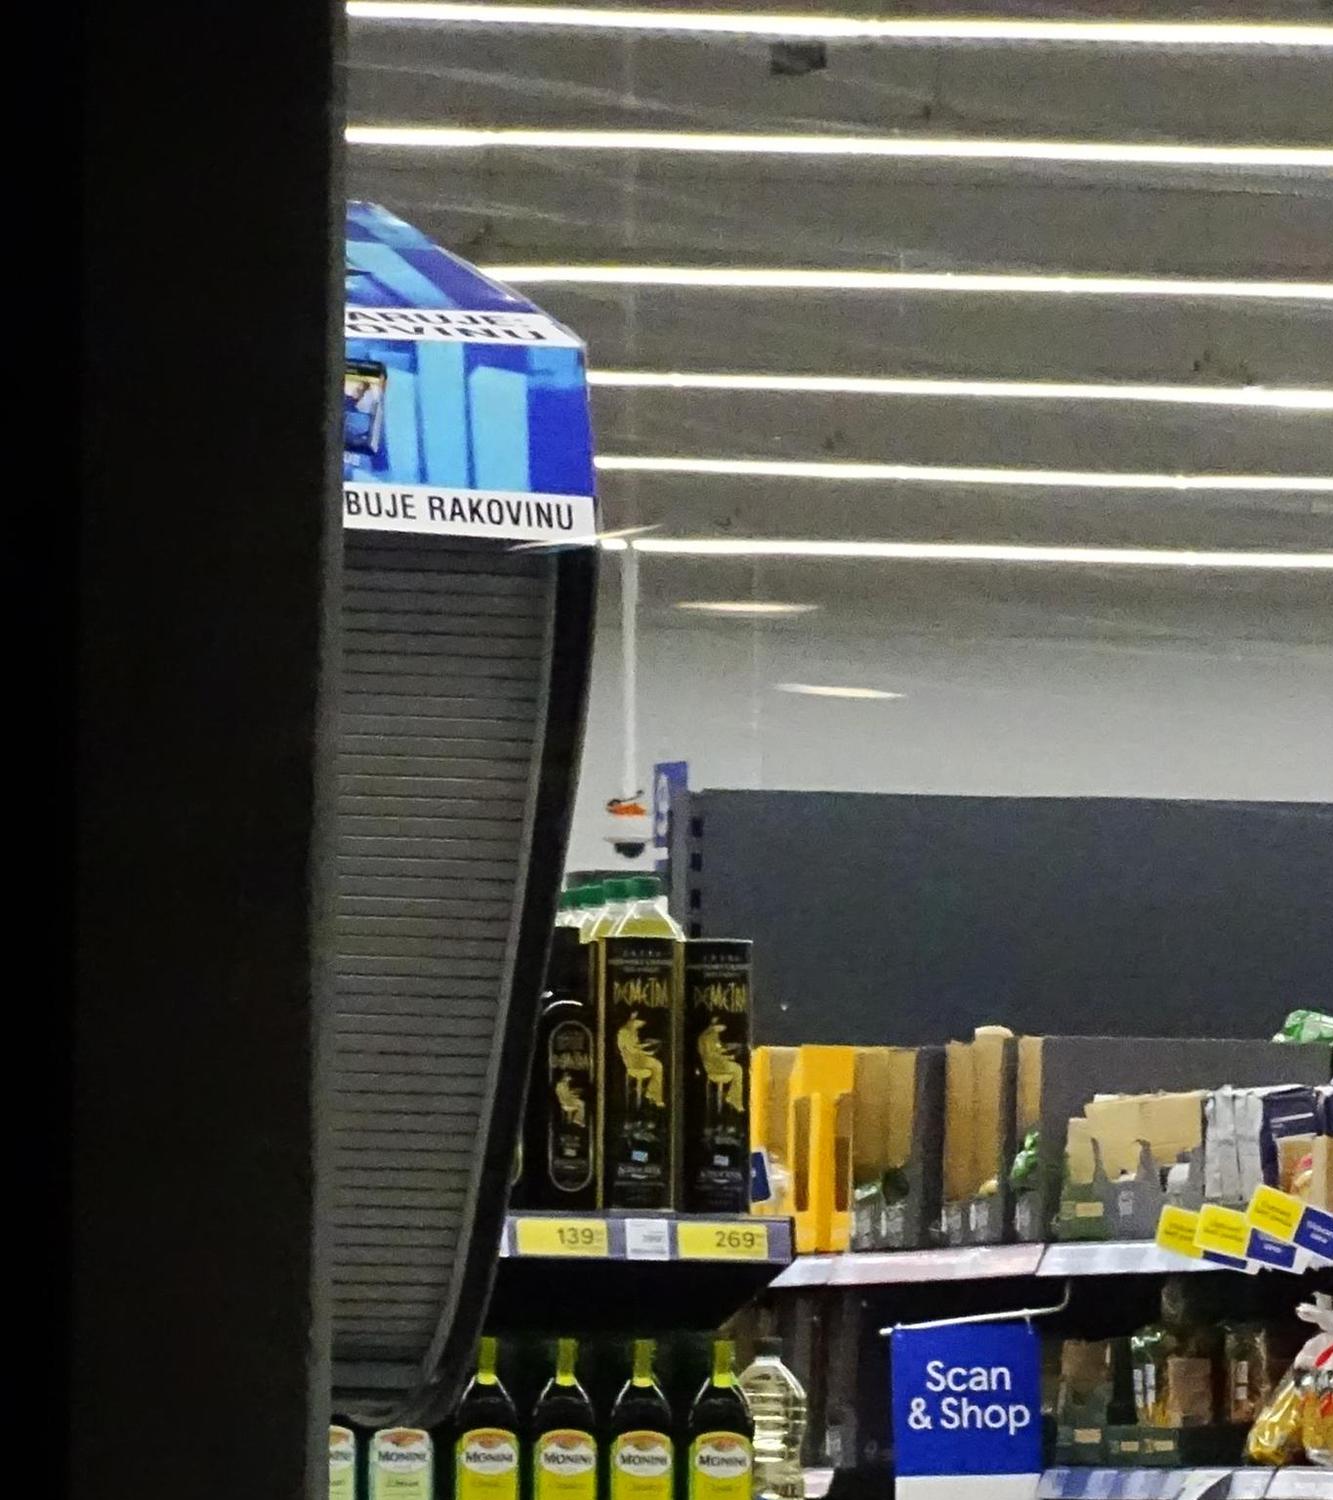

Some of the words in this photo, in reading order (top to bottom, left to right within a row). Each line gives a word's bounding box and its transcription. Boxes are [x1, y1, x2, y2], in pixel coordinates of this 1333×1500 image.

[345, 491, 417, 520] BUJE
[428, 495, 573, 531] RAKOVINU
[557, 1227, 594, 1246] 139
[715, 1231, 755, 1249] 269
[926, 1360, 1011, 1393] Scan
[908, 1398, 932, 1430] &
[940, 1397, 1031, 1436] Shop
